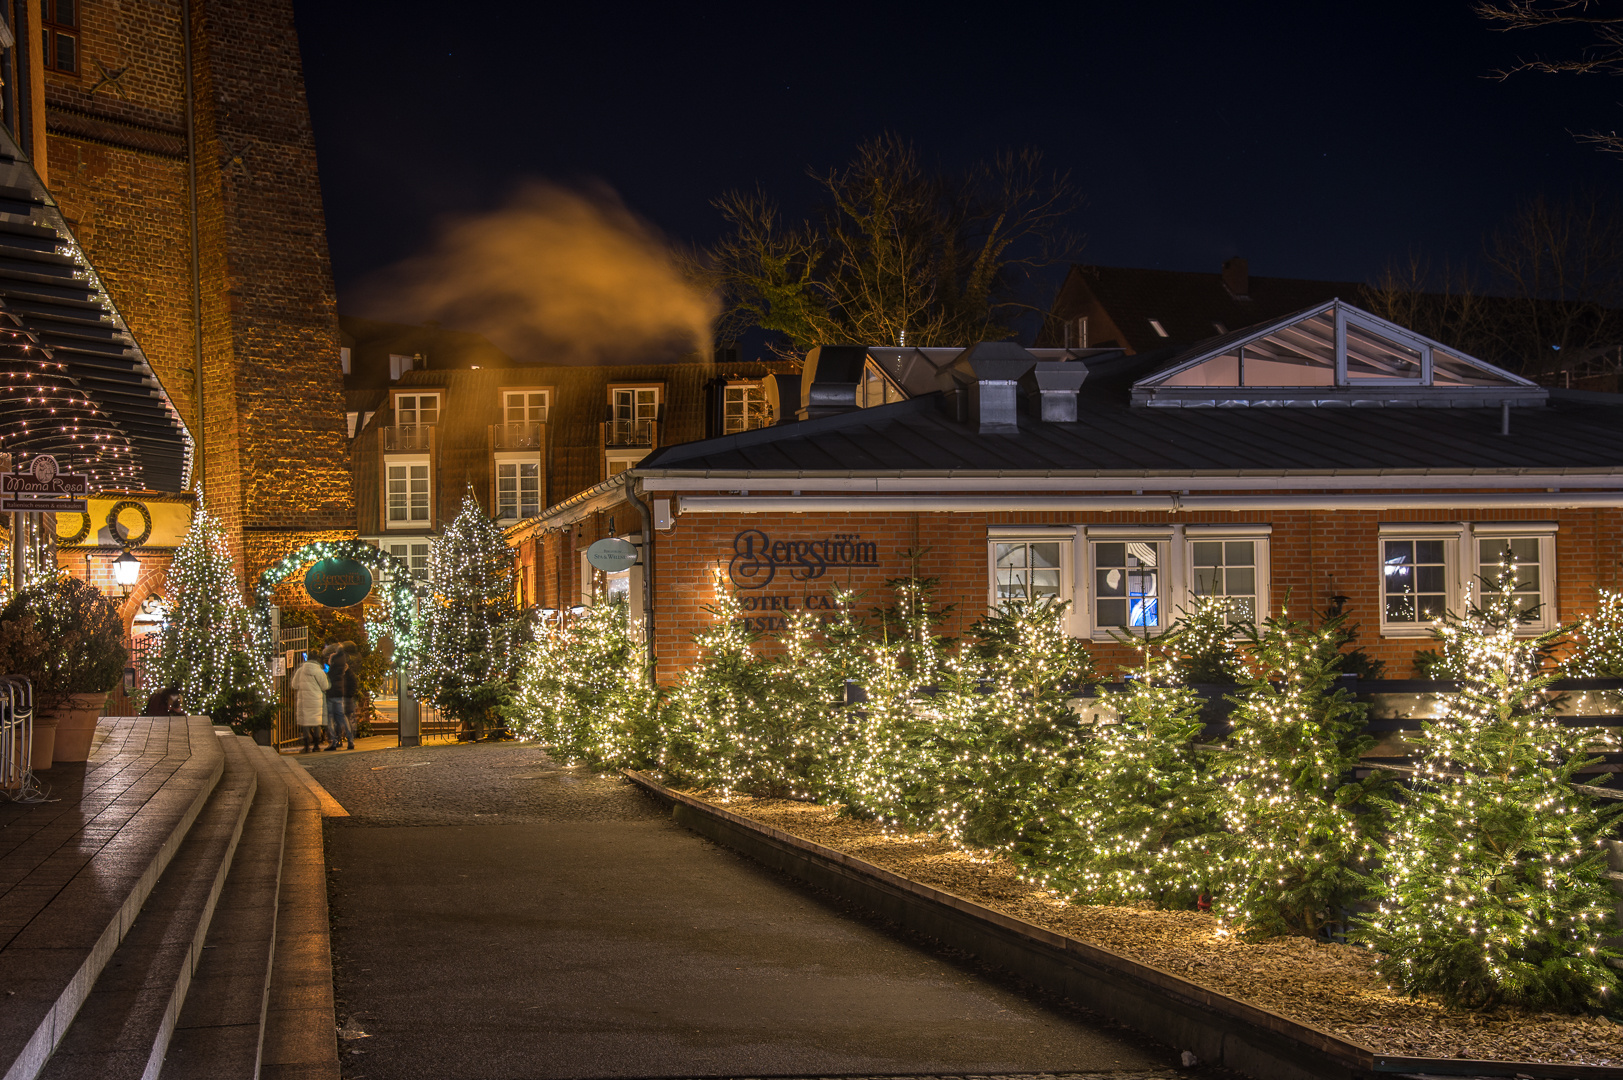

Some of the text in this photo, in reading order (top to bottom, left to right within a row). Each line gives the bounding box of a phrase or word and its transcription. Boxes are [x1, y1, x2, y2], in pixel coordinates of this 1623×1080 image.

[3, 476, 83, 495] Mama Rosa
[729, 529, 880, 590] Bergström
[730, 615, 858, 632] ESTAAN
